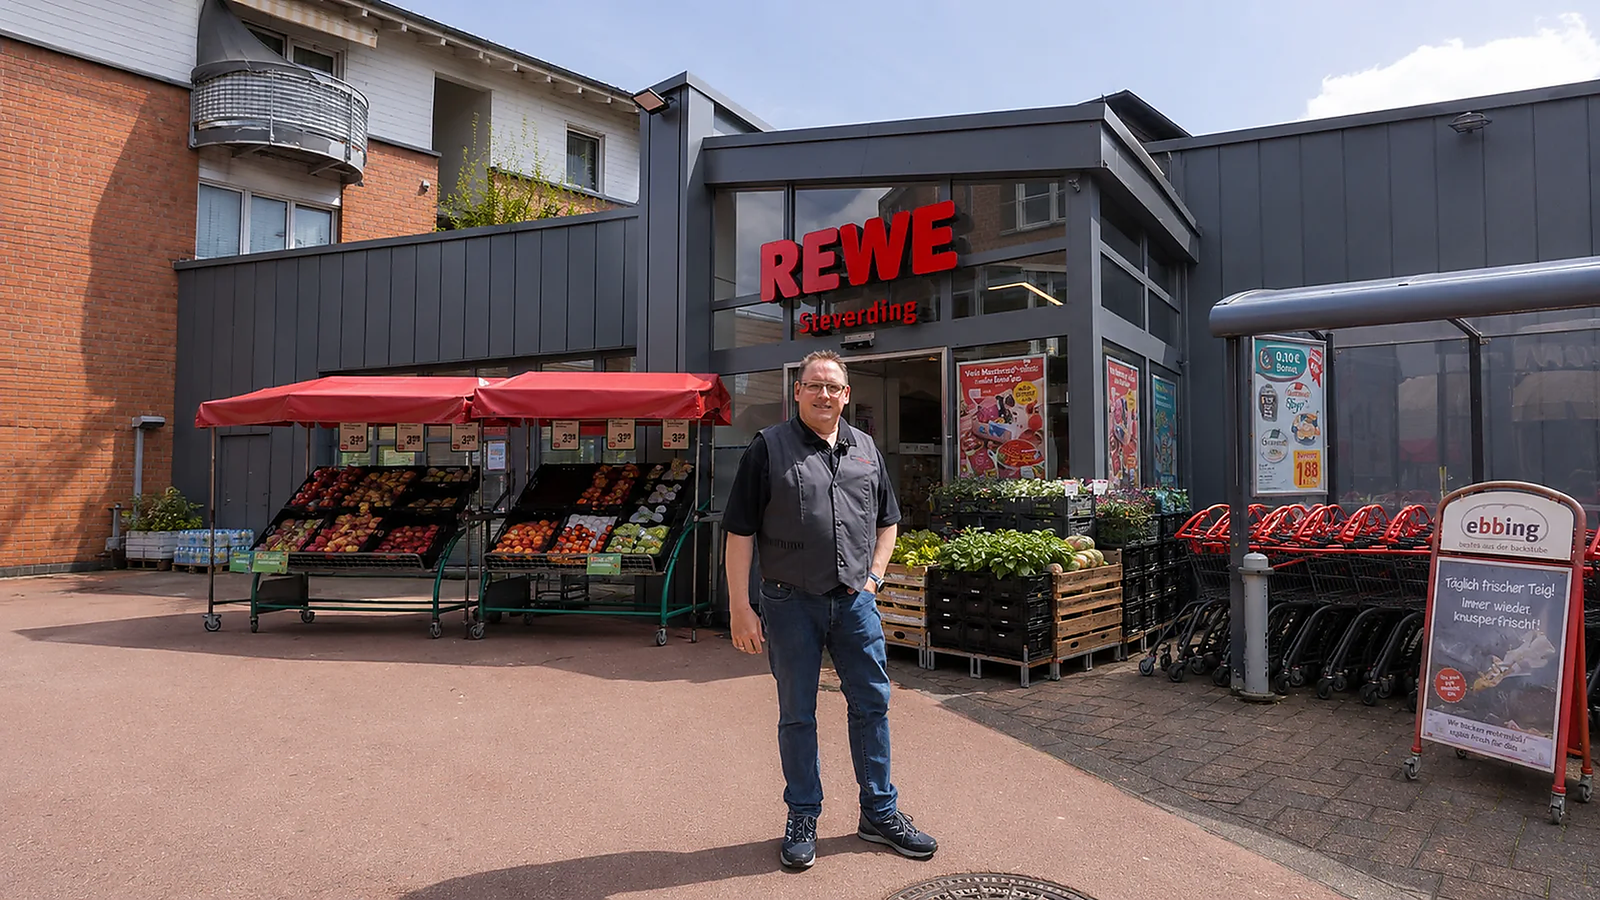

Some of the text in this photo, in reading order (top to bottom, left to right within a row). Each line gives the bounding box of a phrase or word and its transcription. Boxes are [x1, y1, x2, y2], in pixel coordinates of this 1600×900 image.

[760, 200, 958, 302] REWE
[799, 300, 917, 334] Steverding
[1466, 516, 1540, 543] ebbing
[1458, 541, 1480, 549] bestes
[1497, 543, 1508, 551] der
[1511, 544, 1549, 553] backstube
[1445, 577, 1555, 598] Täglich frischer Teig!
[1461, 597, 1491, 610] Immer
